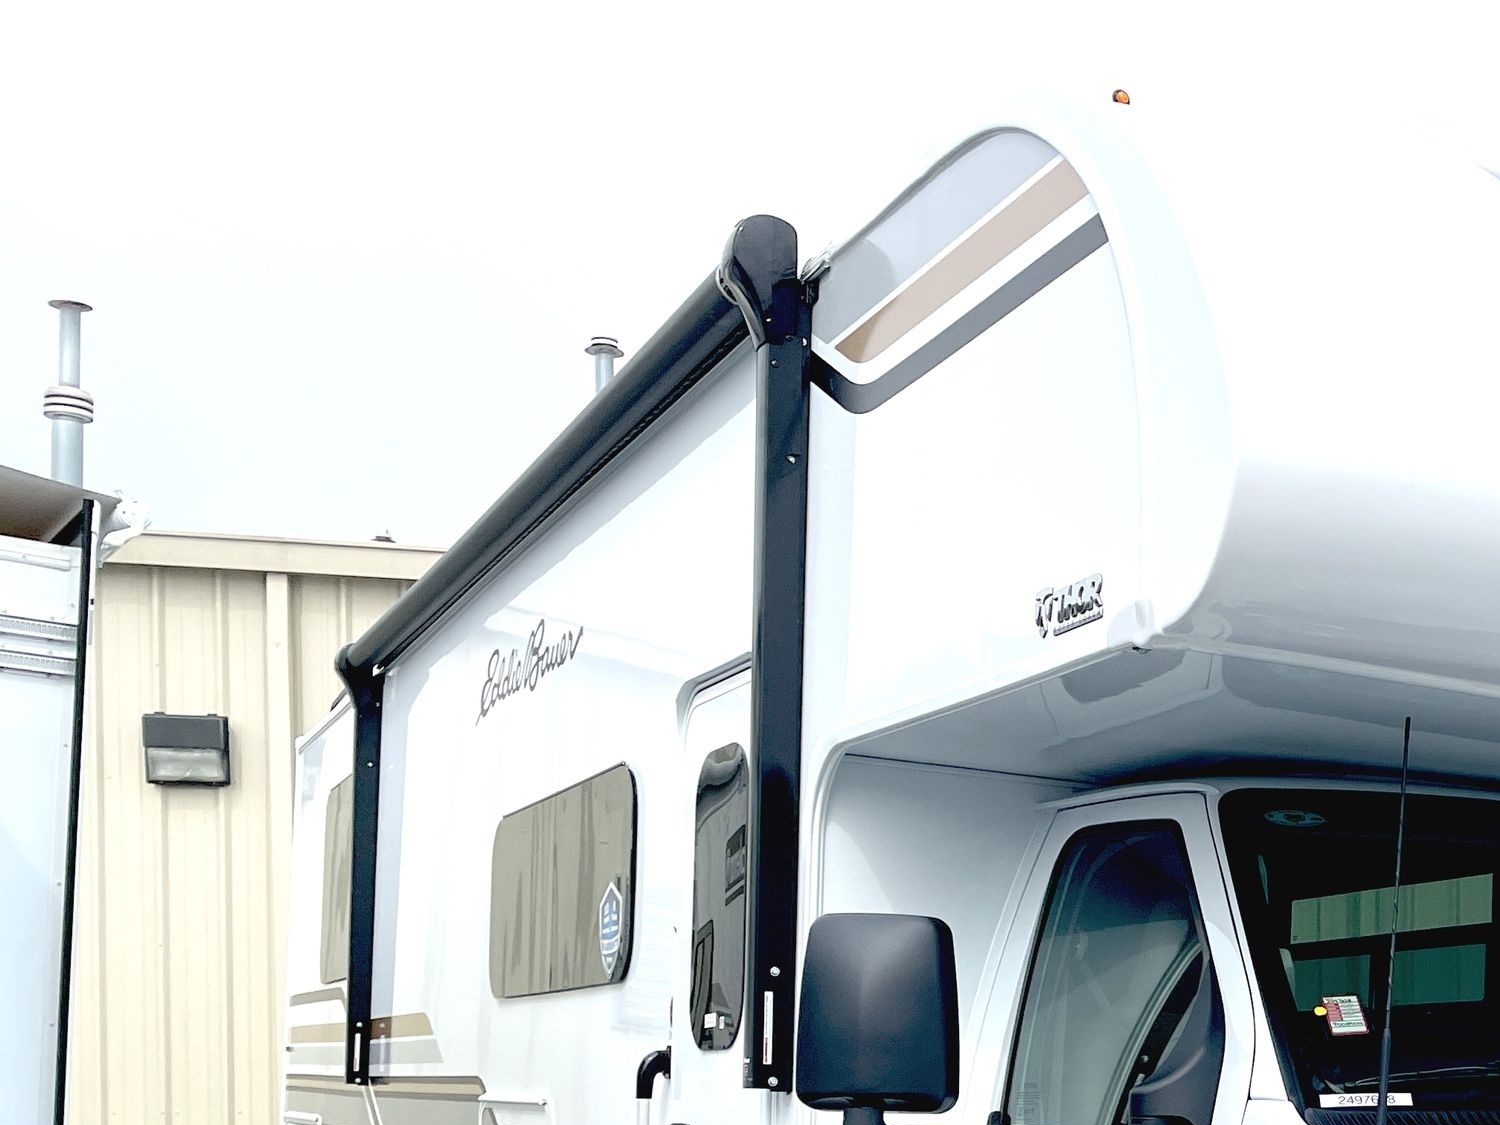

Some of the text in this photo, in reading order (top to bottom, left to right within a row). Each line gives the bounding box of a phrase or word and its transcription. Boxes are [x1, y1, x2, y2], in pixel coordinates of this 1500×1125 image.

[475, 618, 583, 727] Eddie Bauer
[1338, 1093, 1396, 1105] 249768
